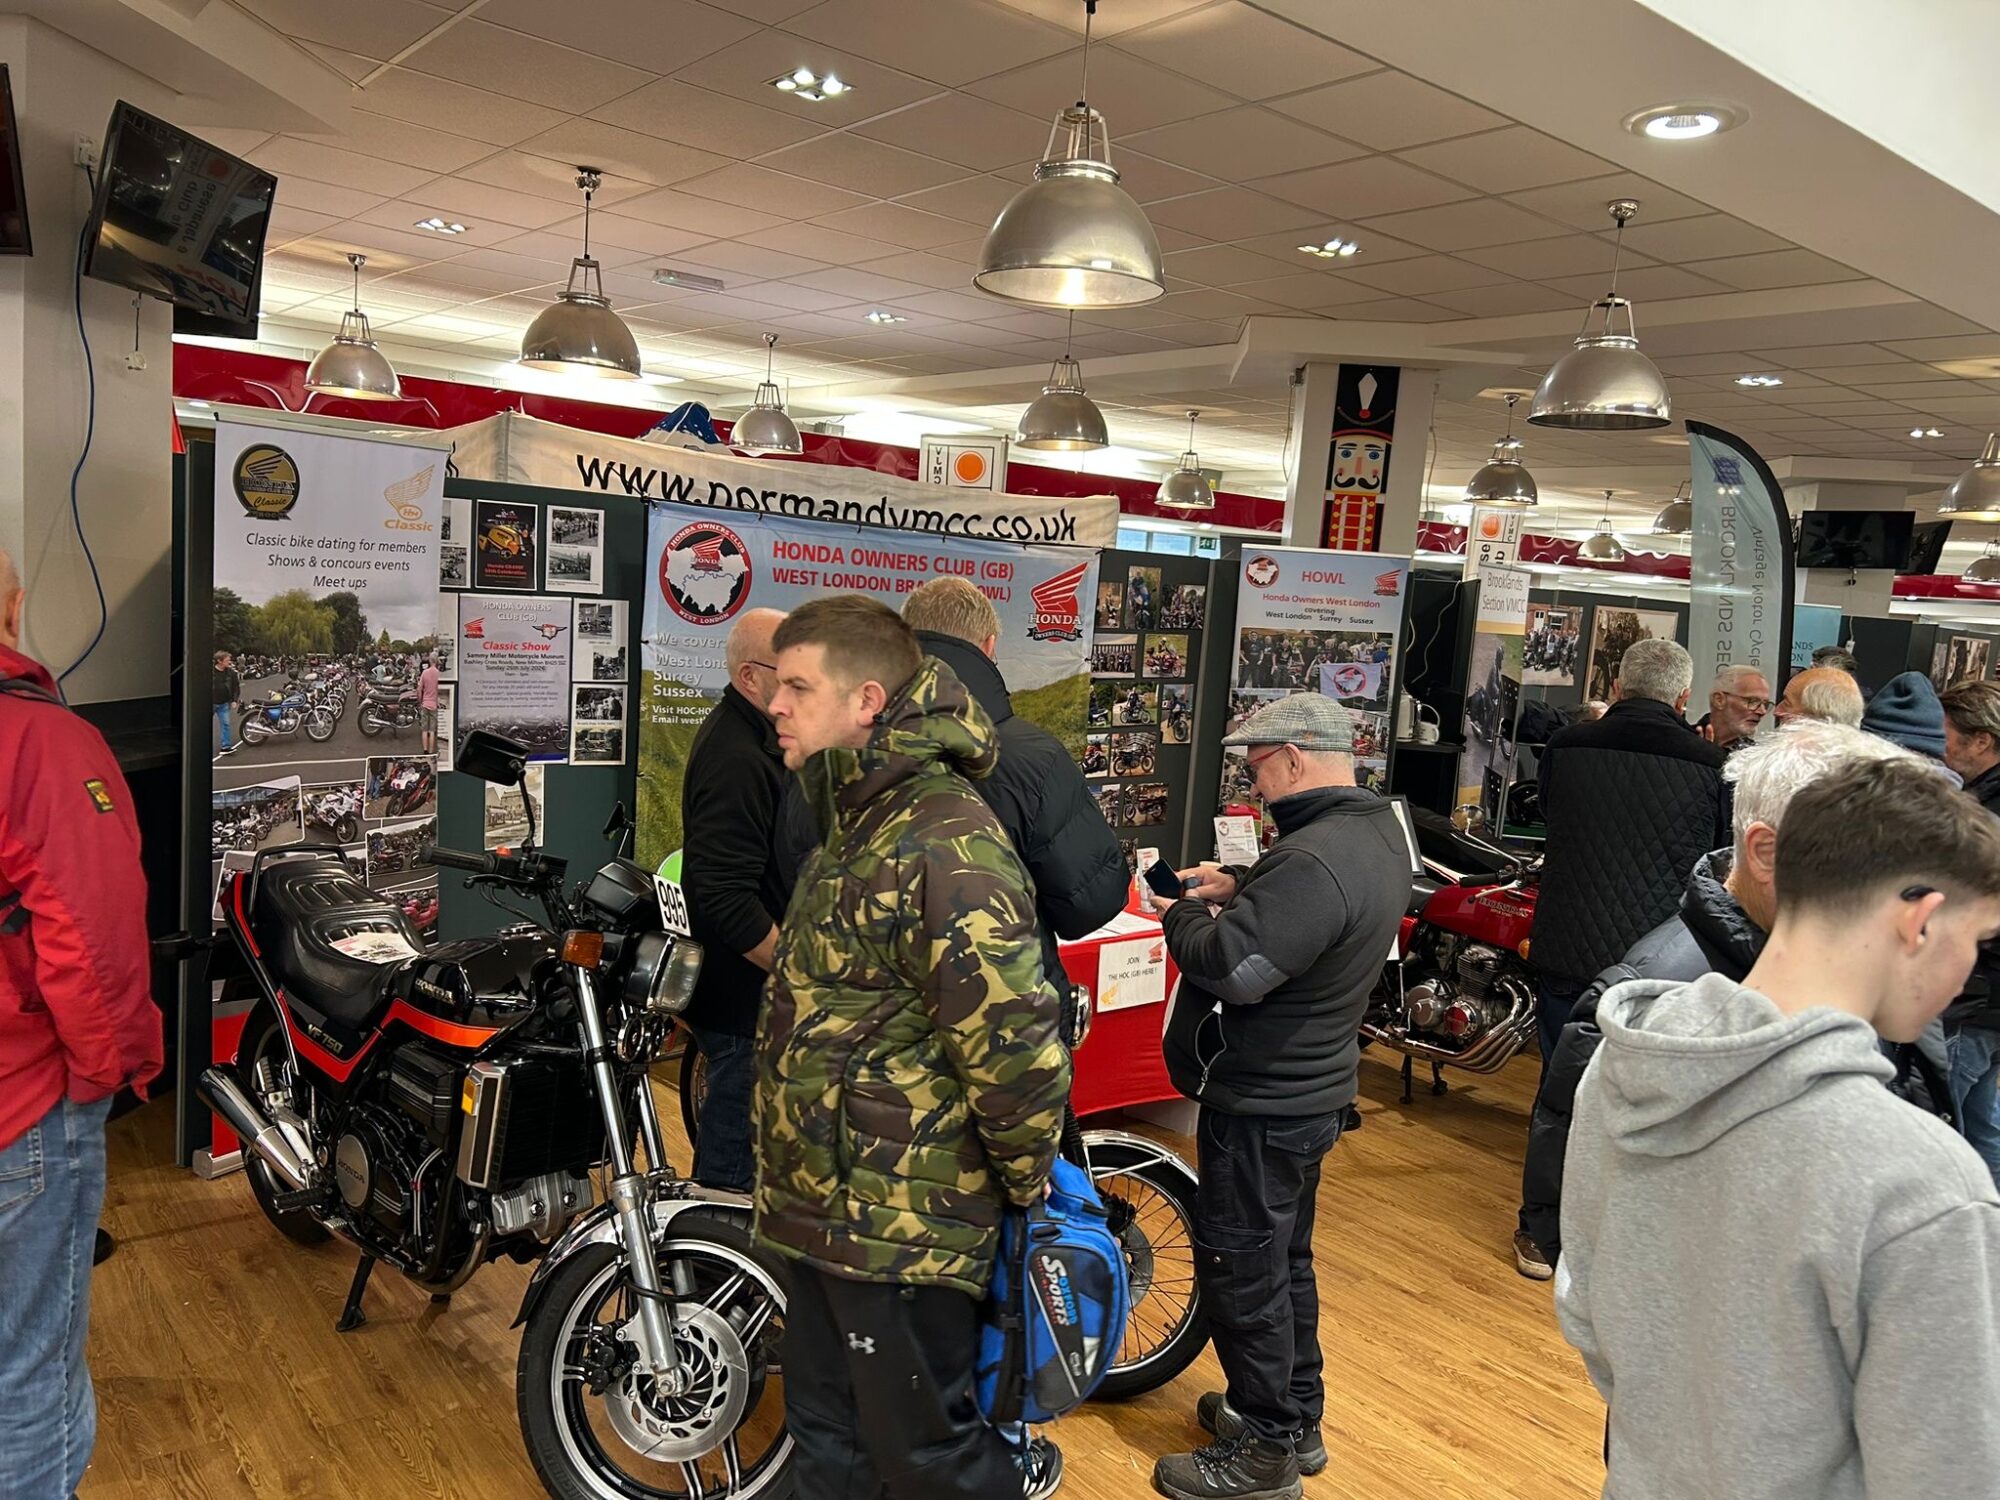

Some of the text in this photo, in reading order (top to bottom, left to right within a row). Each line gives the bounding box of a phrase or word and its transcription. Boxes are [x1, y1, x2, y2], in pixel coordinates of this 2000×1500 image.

[254, 496, 287, 507] Classic
[577, 454, 1076, 541] www.normandymcc.co.uk
[384, 519, 433, 532] Classic
[246, 532, 427, 554] Classic bike dating for members
[670, 523, 746, 554] HONDA OWNERS CLUB
[267, 554, 410, 571] Shows & concours events
[773, 540, 1015, 582] HONDA OWNERS CLUB (GB)
[313, 575, 367, 591] Meet ups
[772, 567, 1011, 602] WEST LONDON BRA OWL)
[1302, 571, 1345, 585] HOWL
[1487, 572, 1523, 591] Brooklands
[482, 601, 551, 612] HONDA OWNERS
[1262, 593, 1380, 609] Honda Owners West London
[1482, 594, 1526, 613] Section VMCC
[678, 609, 729, 624] WEST LONDON
[1285, 612, 1312, 620] London
[1319, 615, 1342, 623] Surrey
[1349, 616, 1374, 624] Sussex
[1304, 607, 1335, 615] covering
[1029, 613, 1082, 625] HONDA
[482, 641, 551, 651] Classic Show
[655, 632, 679, 646] We
[655, 653, 693, 667] West
[653, 670, 702, 686] Surrey
[653, 684, 703, 698] Sussex
[652, 705, 713, 715] Visit HOC-HO
[652, 715, 705, 725] Email west
[658, 880, 687, 930] 995
[1127, 956, 1140, 965] JOIN
[1118, 971, 1129, 979] HOC
[1041, 1255, 1070, 1326] SPORTS
[1058, 1275, 1078, 1325] OXFORD
